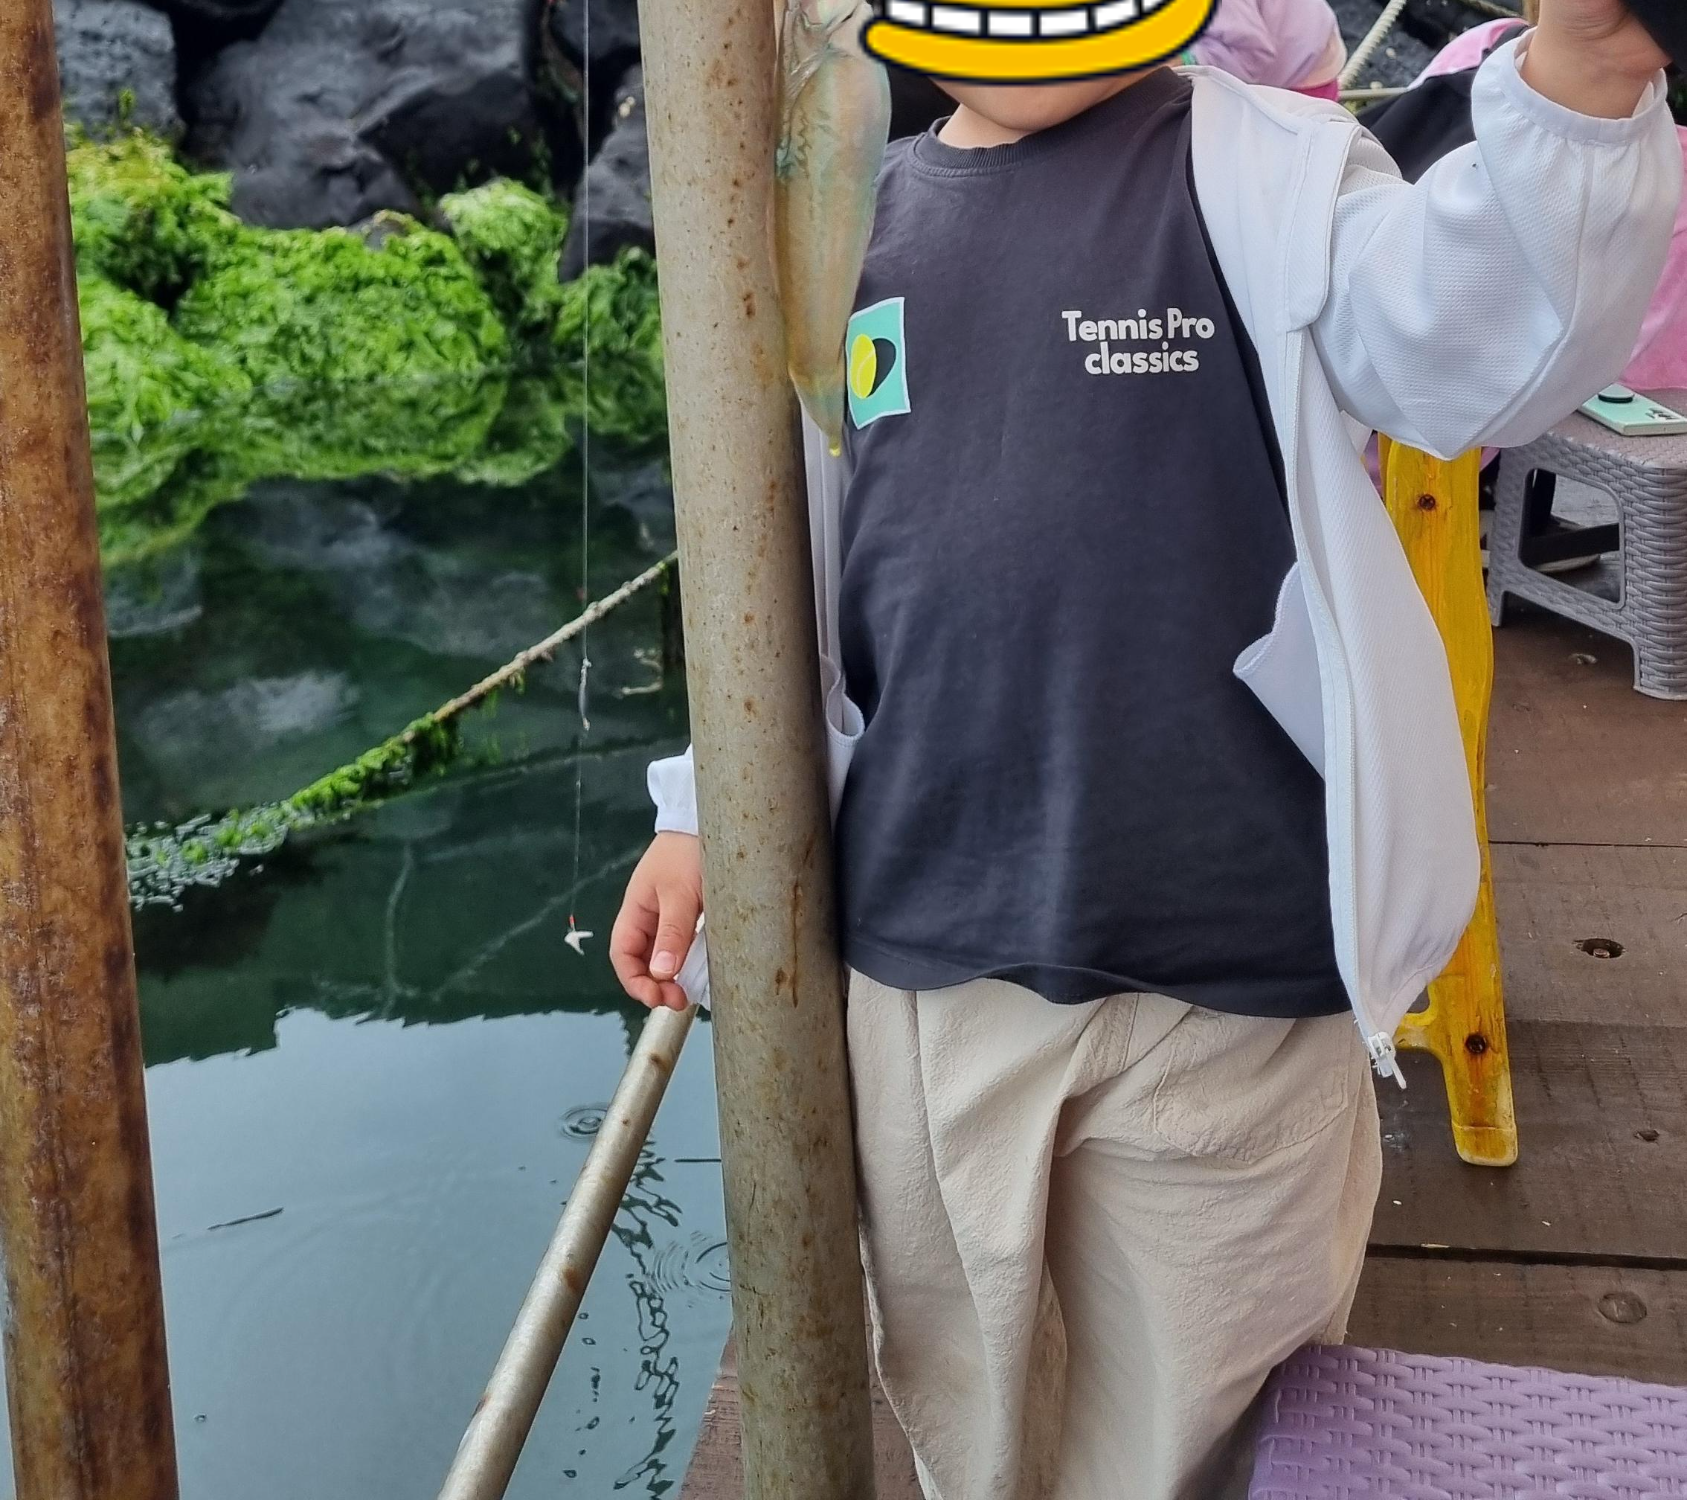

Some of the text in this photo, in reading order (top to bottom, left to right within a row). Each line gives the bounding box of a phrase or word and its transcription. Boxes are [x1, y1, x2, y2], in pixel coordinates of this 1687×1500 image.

[1061, 307, 1215, 342] Tennis Pro
[1084, 341, 1200, 375] classics
